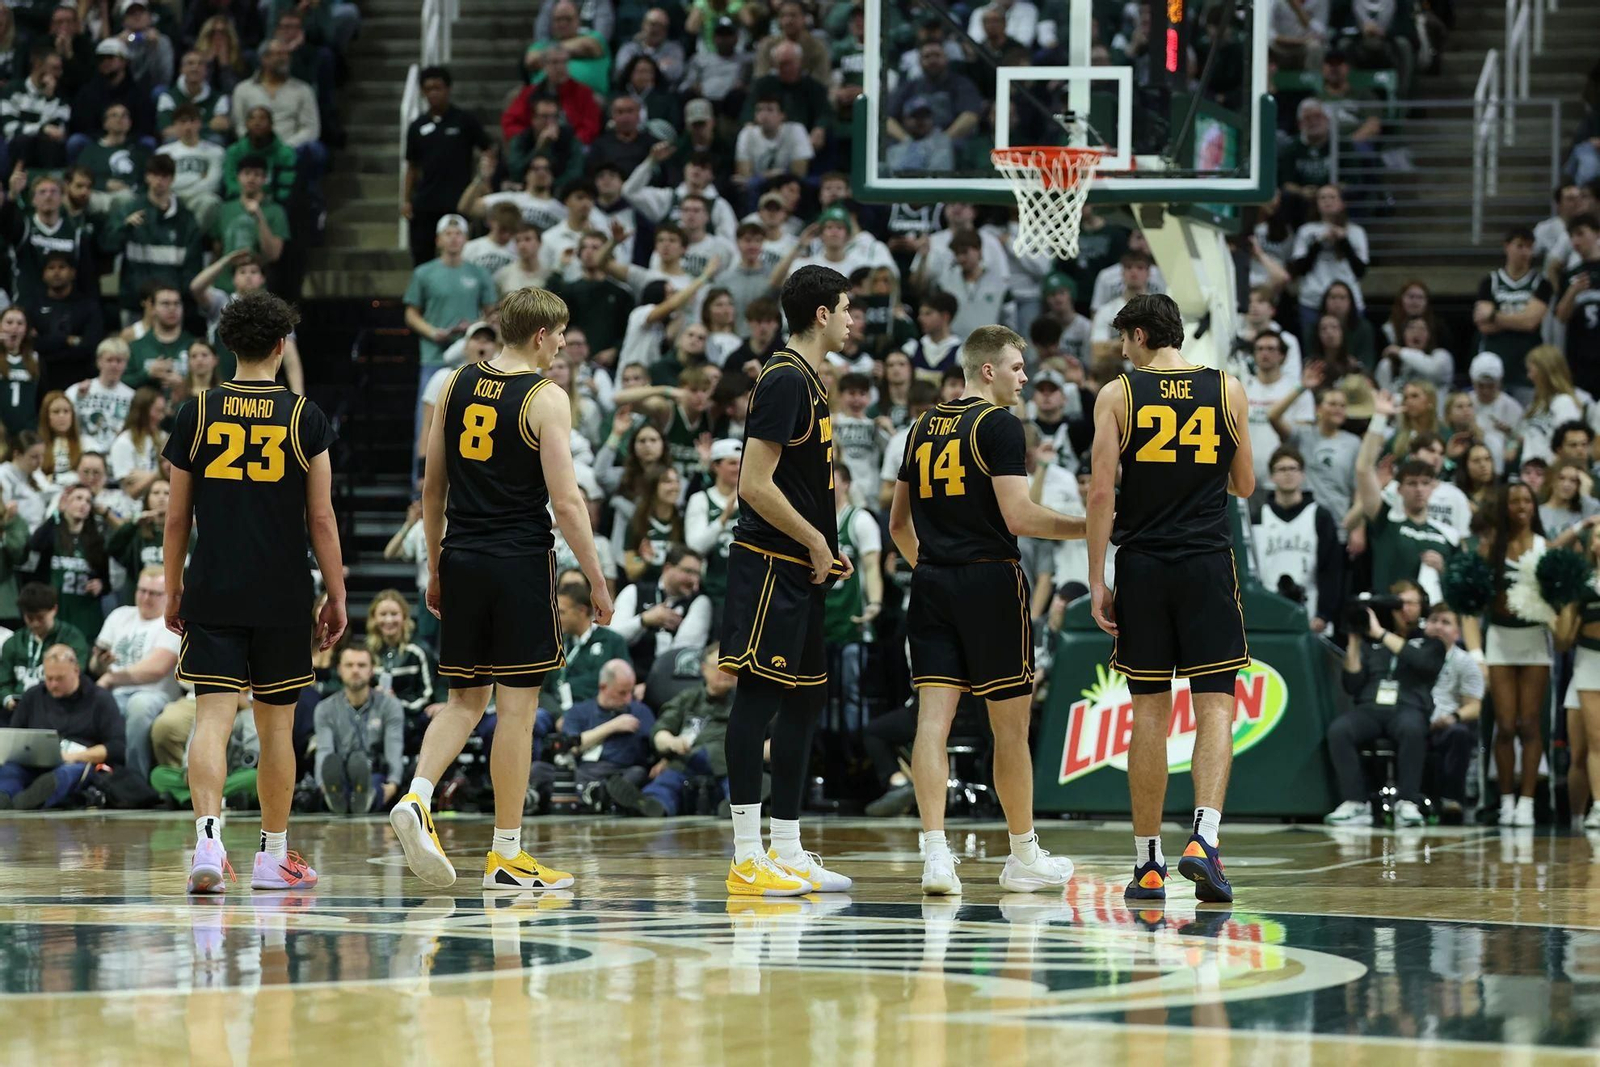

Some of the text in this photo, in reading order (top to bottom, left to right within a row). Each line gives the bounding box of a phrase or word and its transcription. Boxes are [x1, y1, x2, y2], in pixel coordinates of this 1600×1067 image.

[223, 396, 274, 418] HOWARD
[473, 378, 505, 400] KOCH
[1160, 379, 1193, 399] SAGE
[204, 421, 287, 482] 23
[459, 403, 498, 462] 8
[927, 415, 962, 436] STIRZ
[1136, 405, 1220, 464] 24
[915, 439, 966, 499] 14
[1064, 675, 1265, 776] LIBMN
